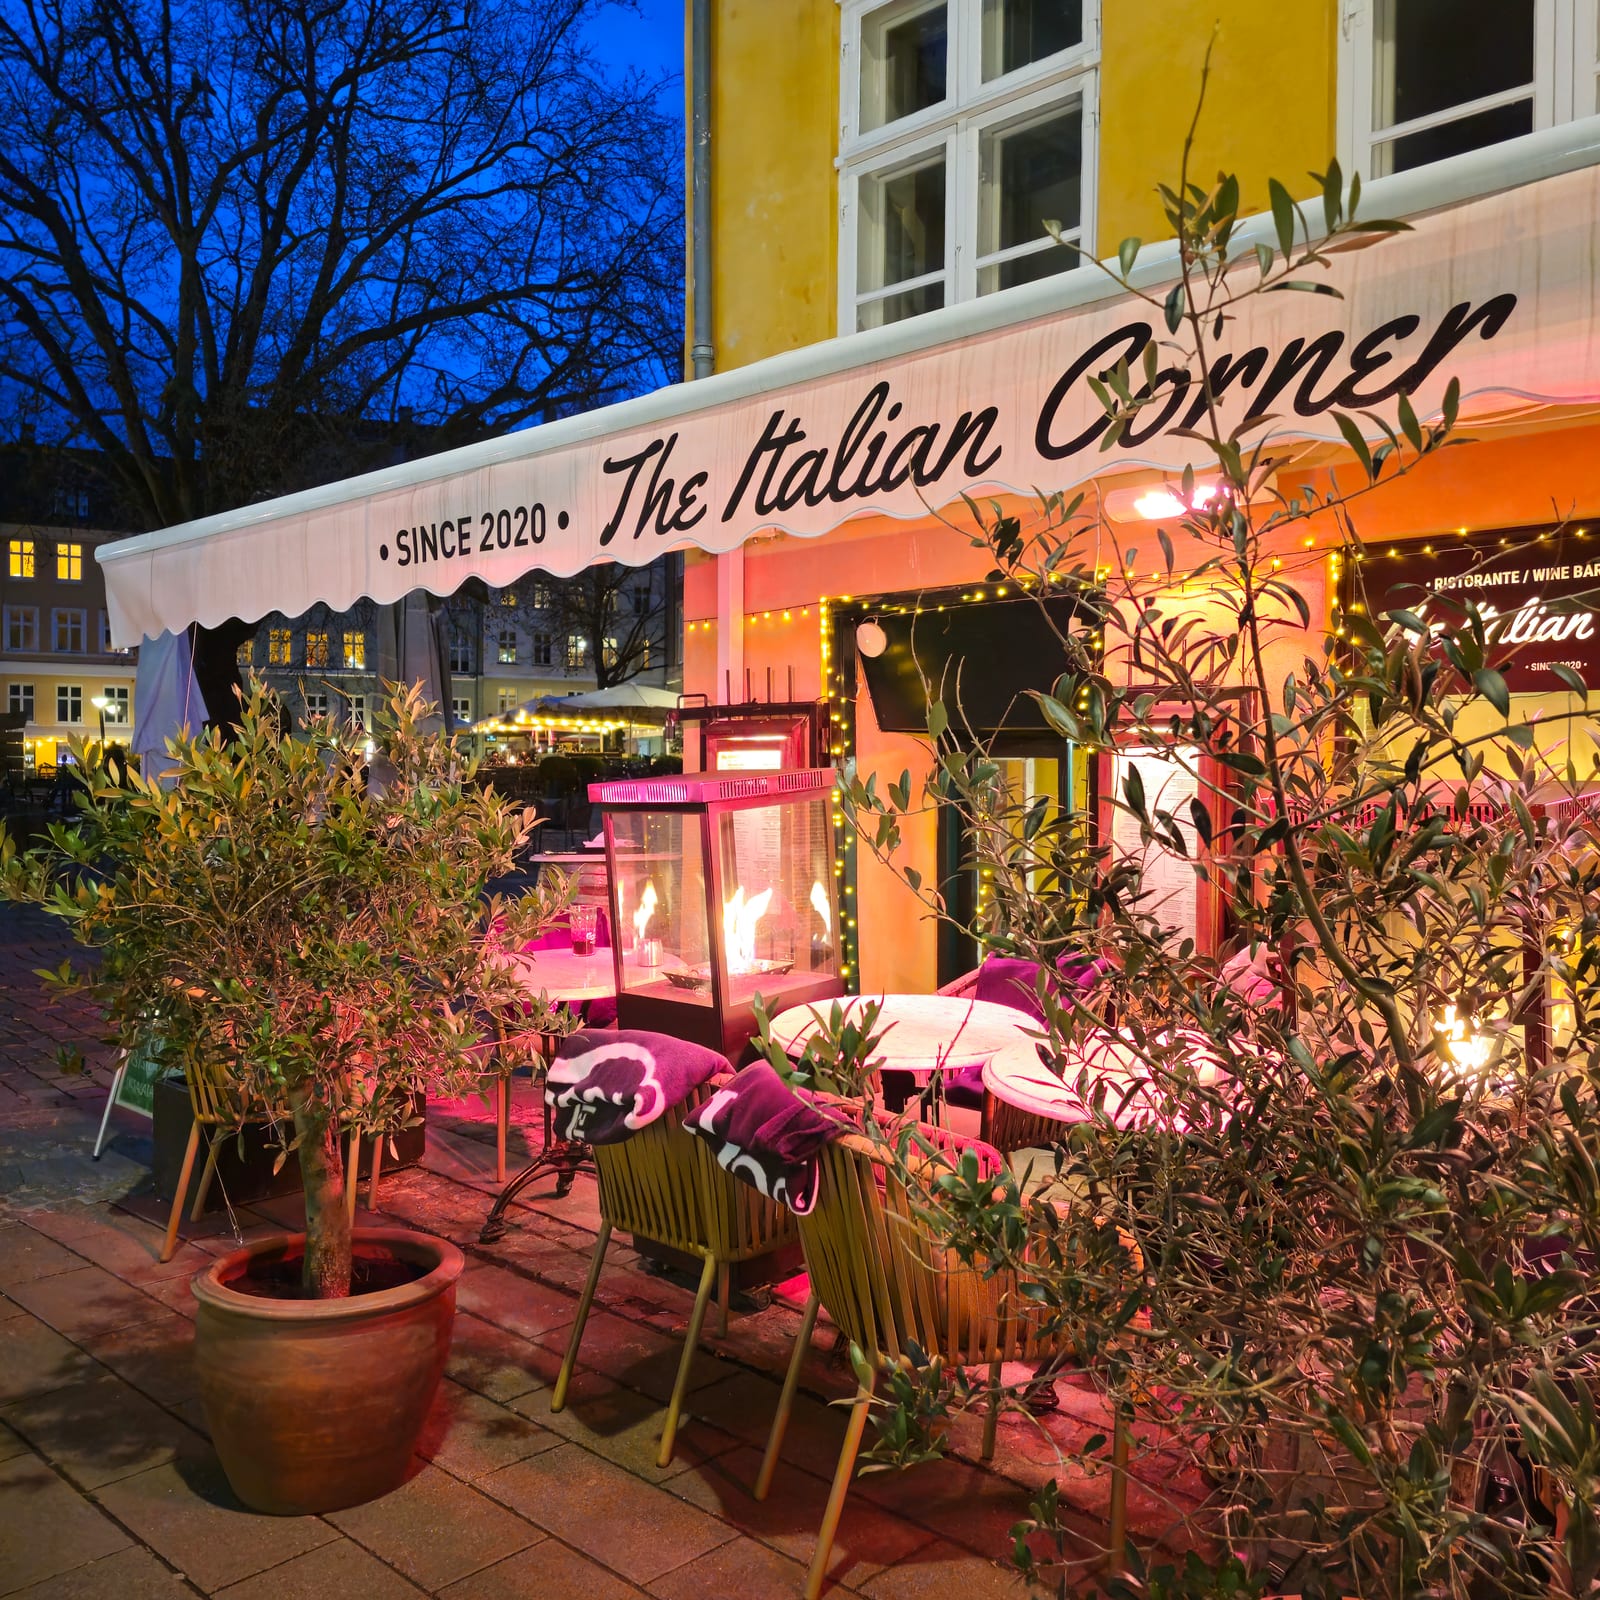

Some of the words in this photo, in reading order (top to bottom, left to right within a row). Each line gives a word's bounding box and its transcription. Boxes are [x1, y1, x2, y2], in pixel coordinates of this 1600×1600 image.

[396, 515, 472, 566] SINCE
[479, 502, 546, 552] 2020
[599, 432, 709, 547] The
[721, 381, 1002, 523] Italian
[1035, 293, 1517, 461] Corner
[1434, 570, 1521, 591] RISTORANTE
[1533, 566, 1570, 582] WINE
[1453, 596, 1595, 649] tlian
[1530, 661, 1559, 671] SINC
